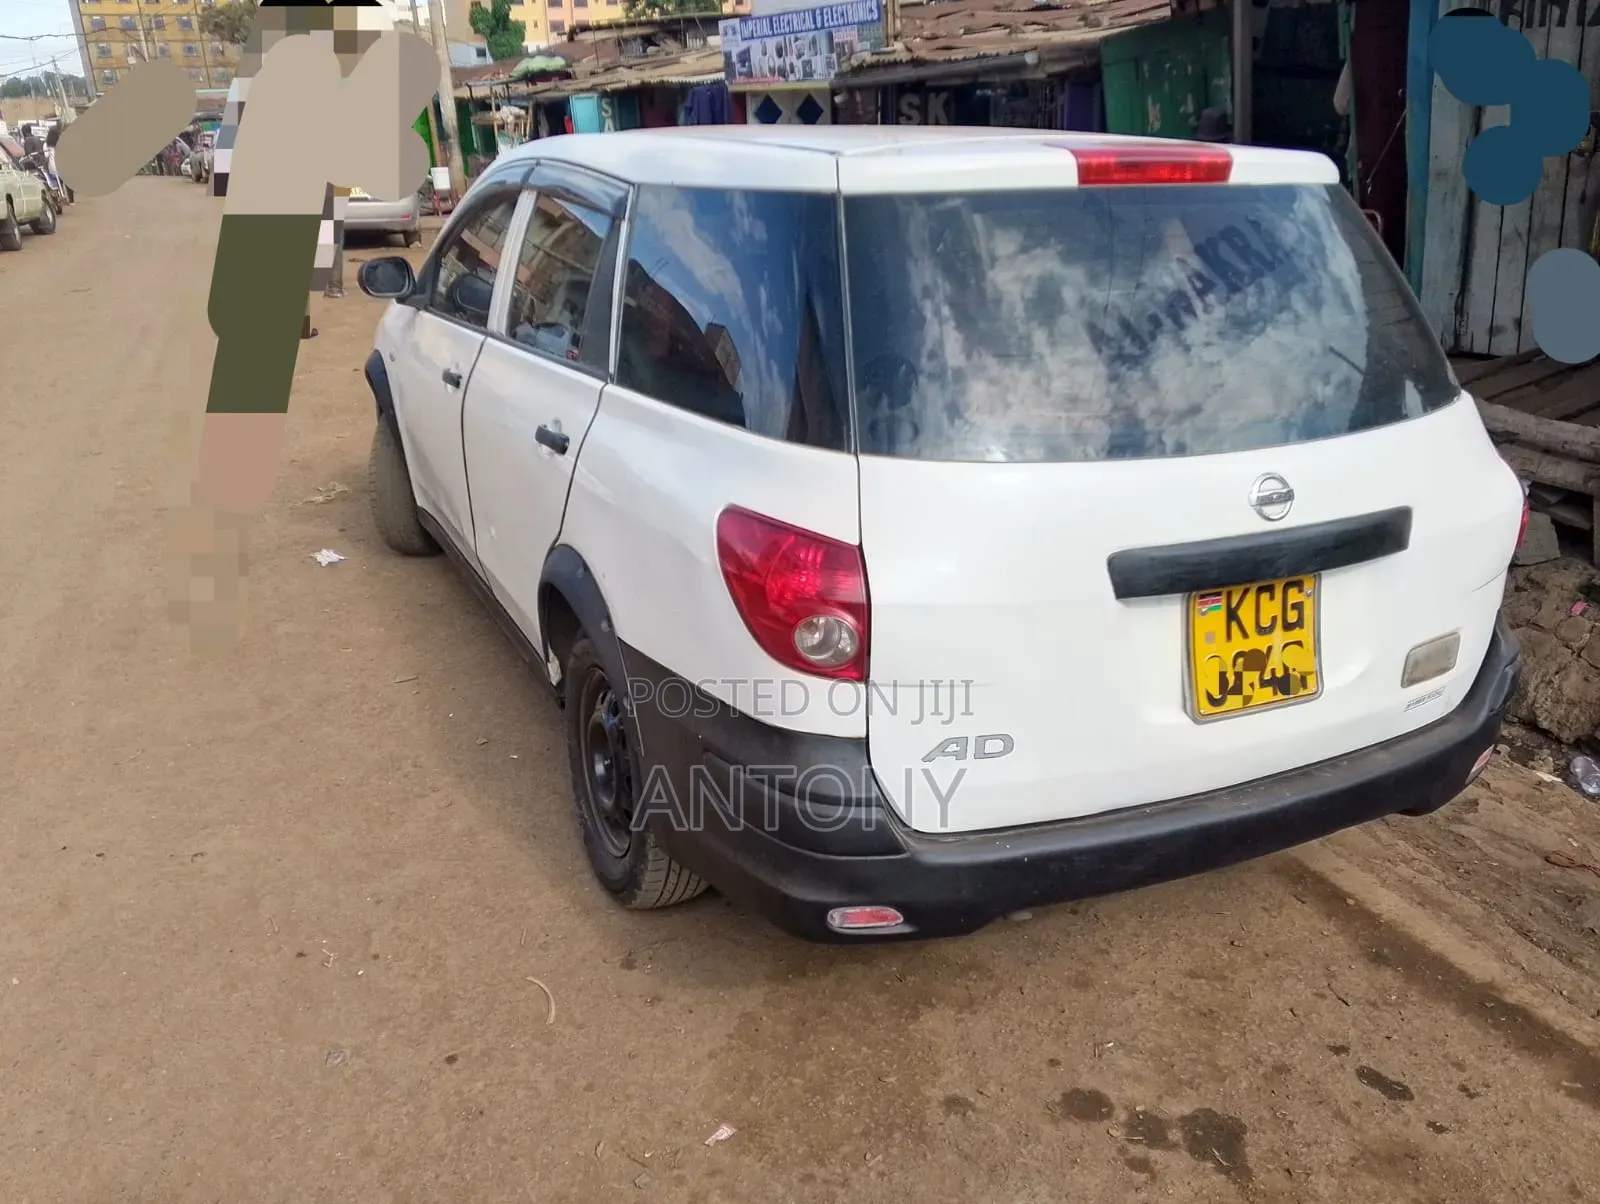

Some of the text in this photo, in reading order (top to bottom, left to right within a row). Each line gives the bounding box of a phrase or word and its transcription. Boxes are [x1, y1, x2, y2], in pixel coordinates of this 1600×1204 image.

[741, 18, 773, 40] IMPERIAL
[773, 10, 815, 35] ELECTRICAL
[823, 0, 879, 27] ELECTRONICS
[1225, 580, 1305, 643] KCG
[921, 733, 1015, 763] AD
